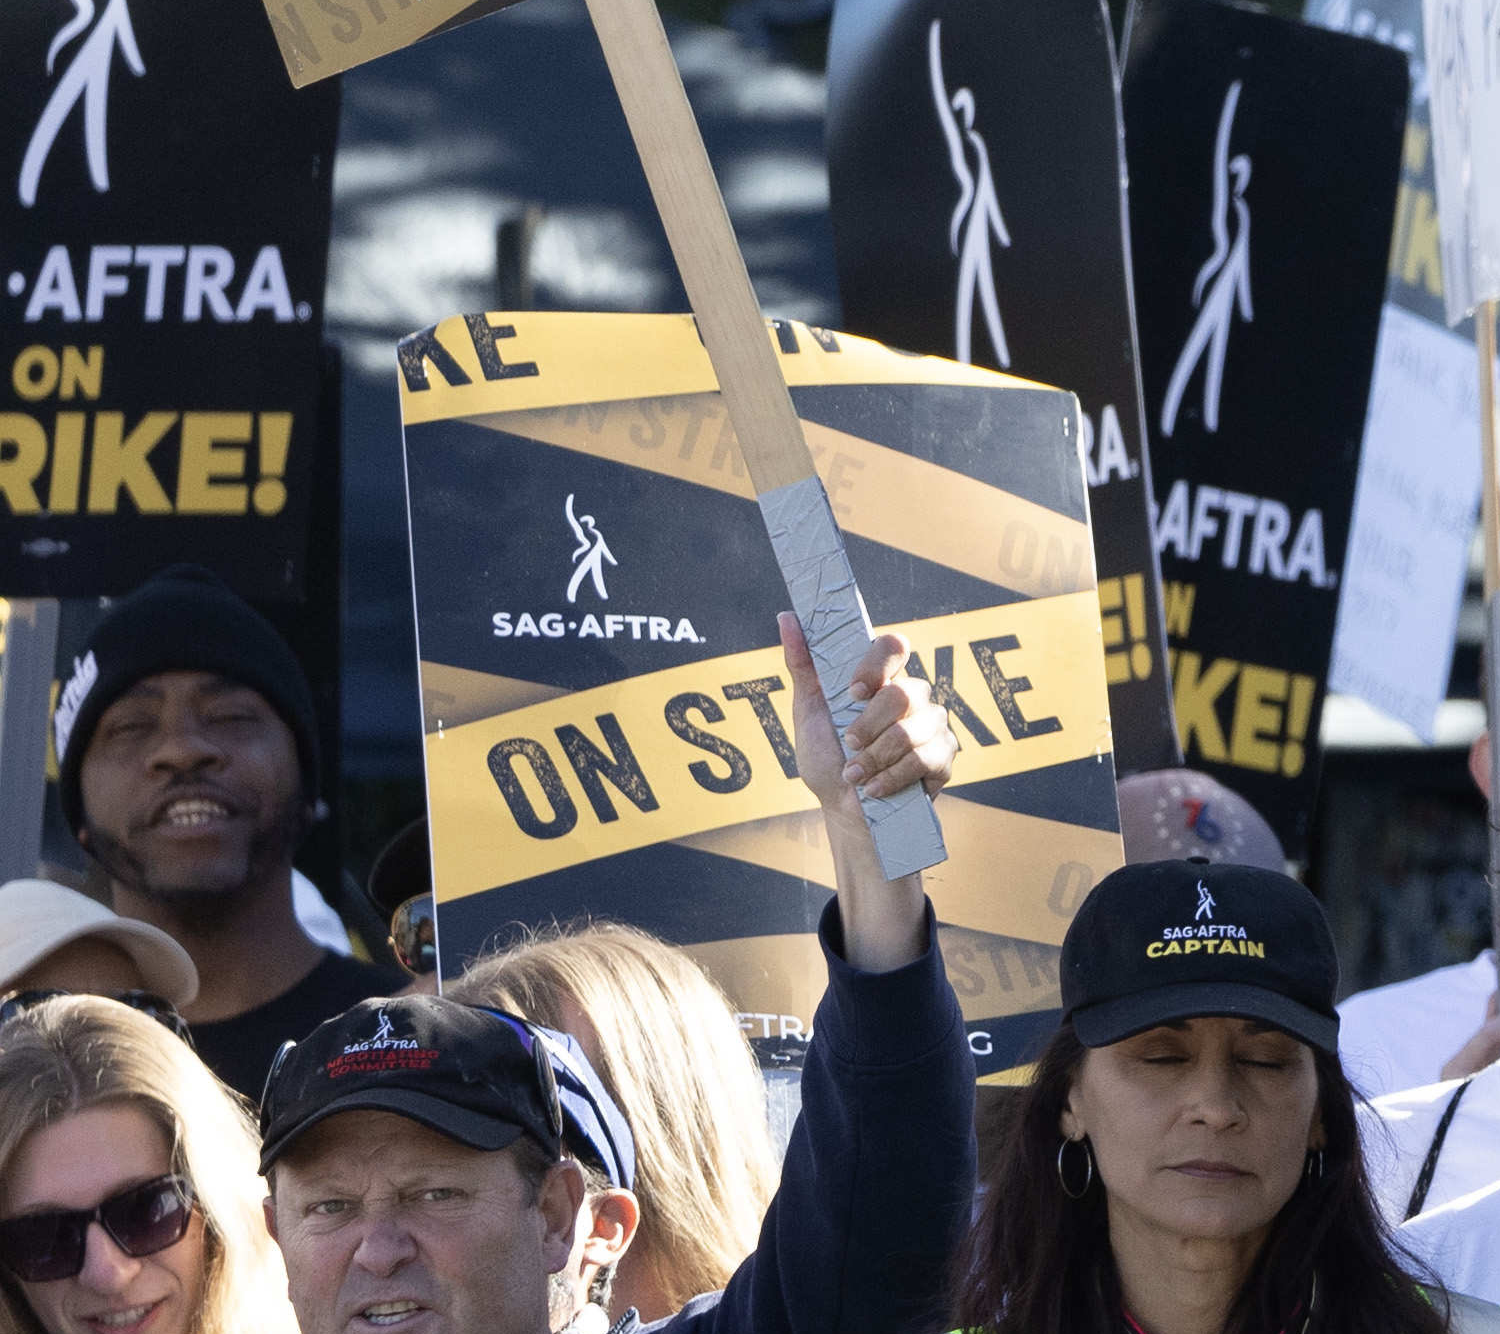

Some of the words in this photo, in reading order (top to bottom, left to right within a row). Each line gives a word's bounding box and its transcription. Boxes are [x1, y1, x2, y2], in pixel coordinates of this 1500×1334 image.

[12, 345, 105, 401] ON
[0, 412, 294, 516] RIKE!
[487, 712, 660, 840] ON
[664, 634, 1063, 794] STKE
[1146, 939, 1266, 959] CAPTAIN
